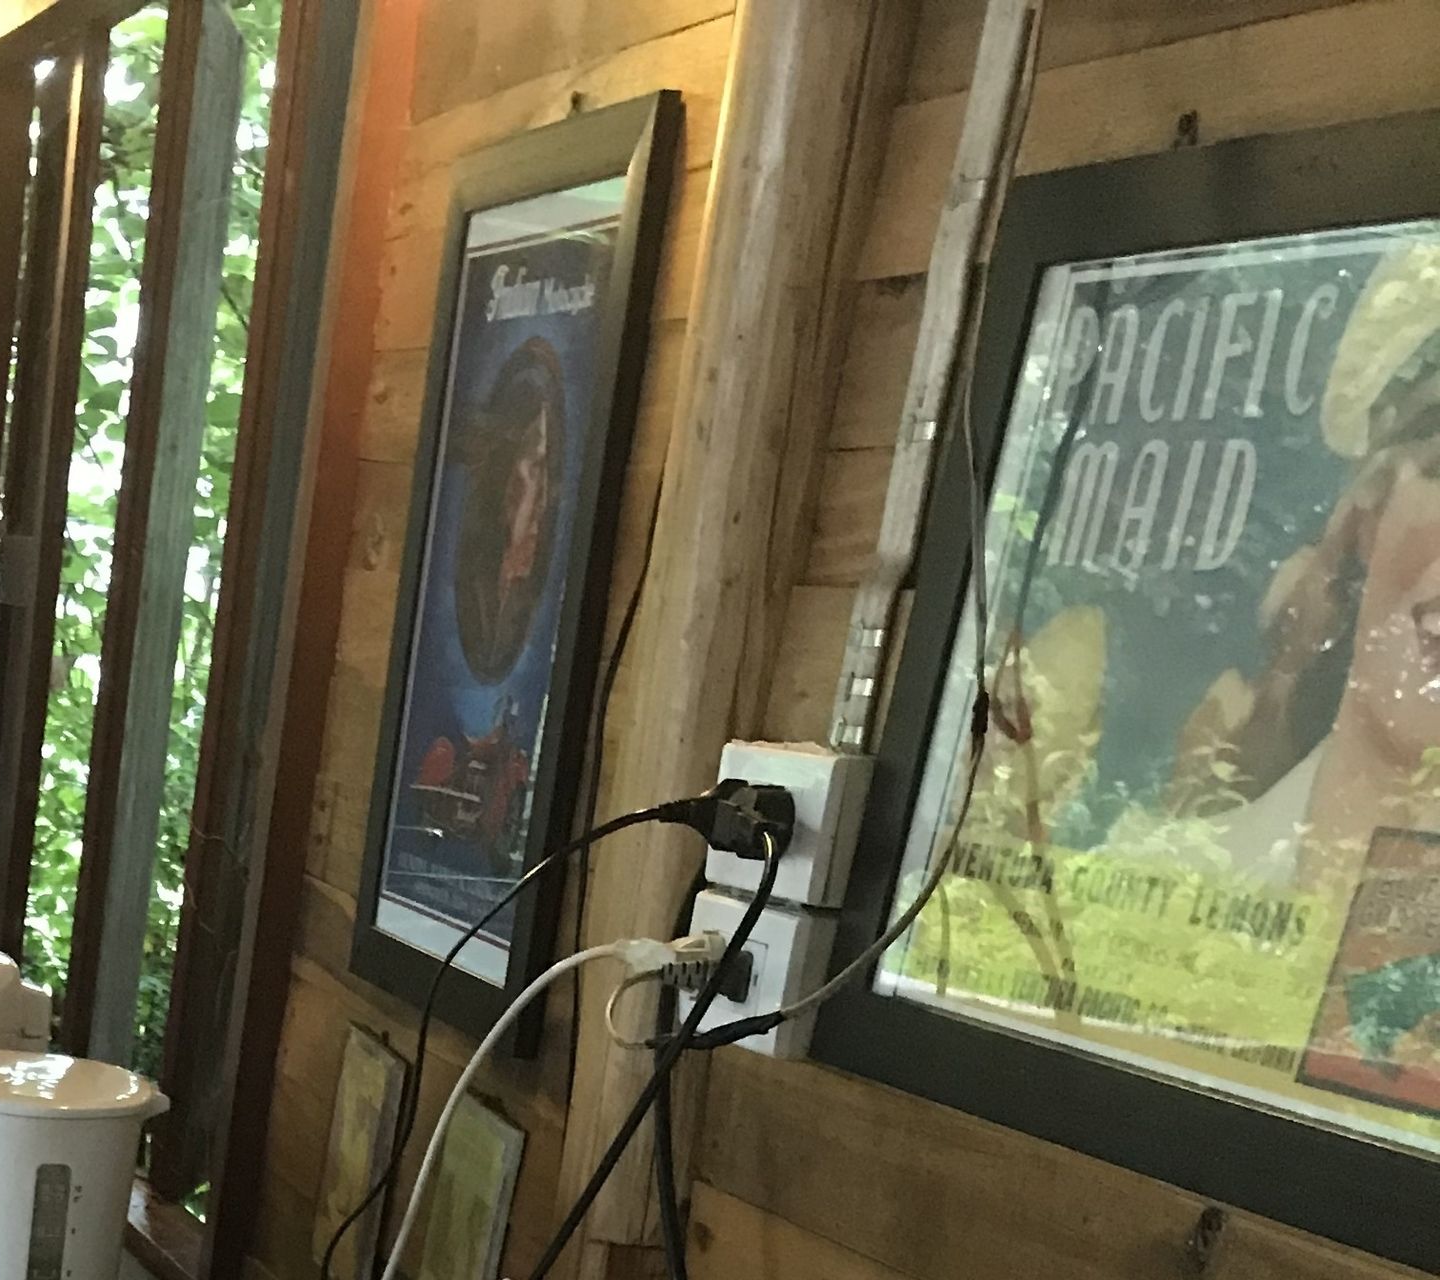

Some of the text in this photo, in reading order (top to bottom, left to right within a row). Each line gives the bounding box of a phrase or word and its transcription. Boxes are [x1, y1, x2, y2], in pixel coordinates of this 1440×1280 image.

[1052, 283, 1340, 425] PACIFIC
[1042, 438, 1258, 572] MAID
[948, 842, 1054, 894] VENTURA
[1069, 863, 1179, 917] COUNTY
[1188, 886, 1312, 948] LEMONS
